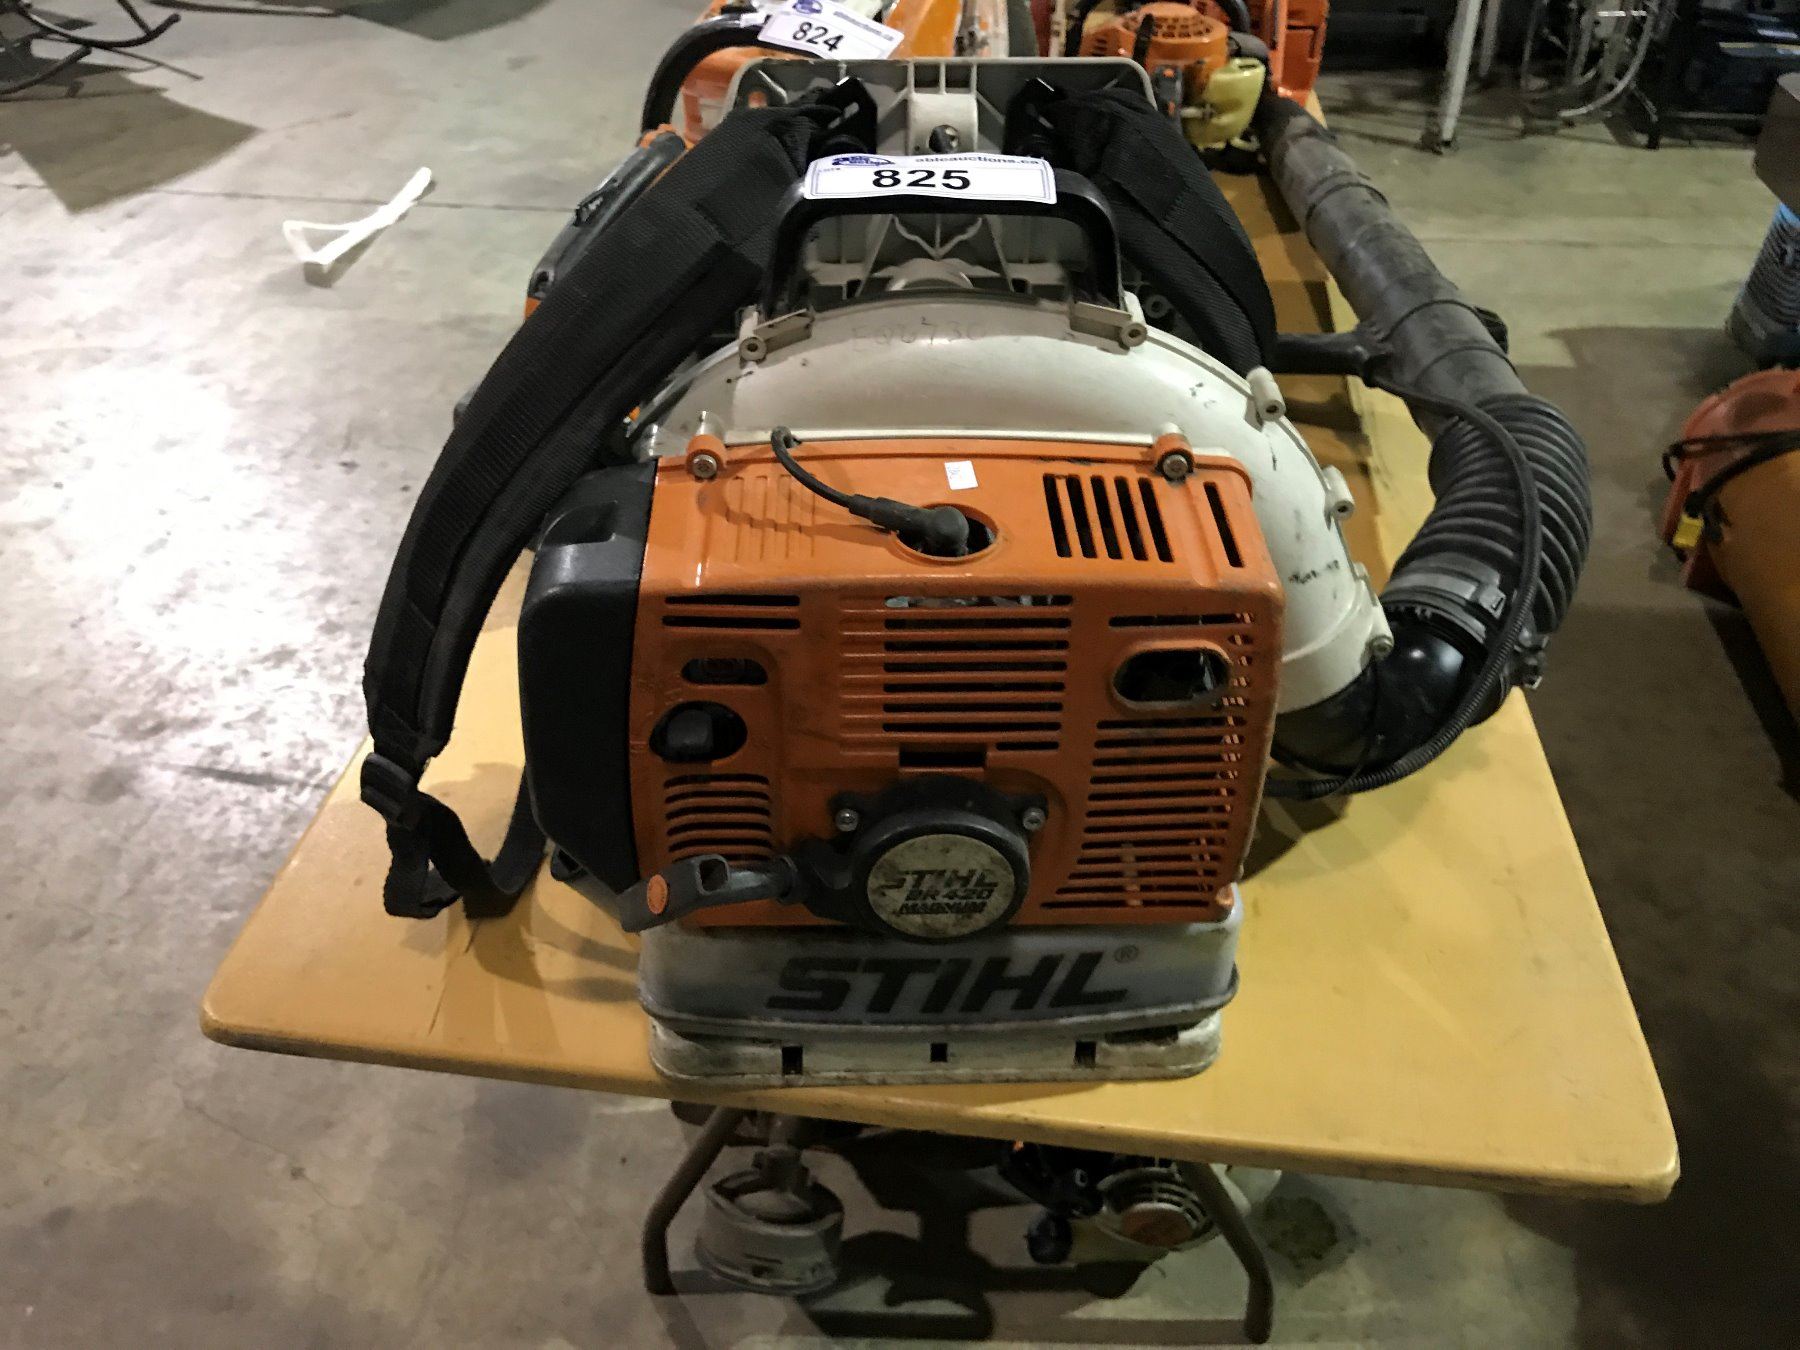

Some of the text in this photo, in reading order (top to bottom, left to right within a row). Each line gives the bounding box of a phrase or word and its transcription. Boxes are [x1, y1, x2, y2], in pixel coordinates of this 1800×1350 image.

[792, 21, 844, 52] 824
[872, 169, 971, 190] 825
[765, 951, 1129, 1014] STIHL
